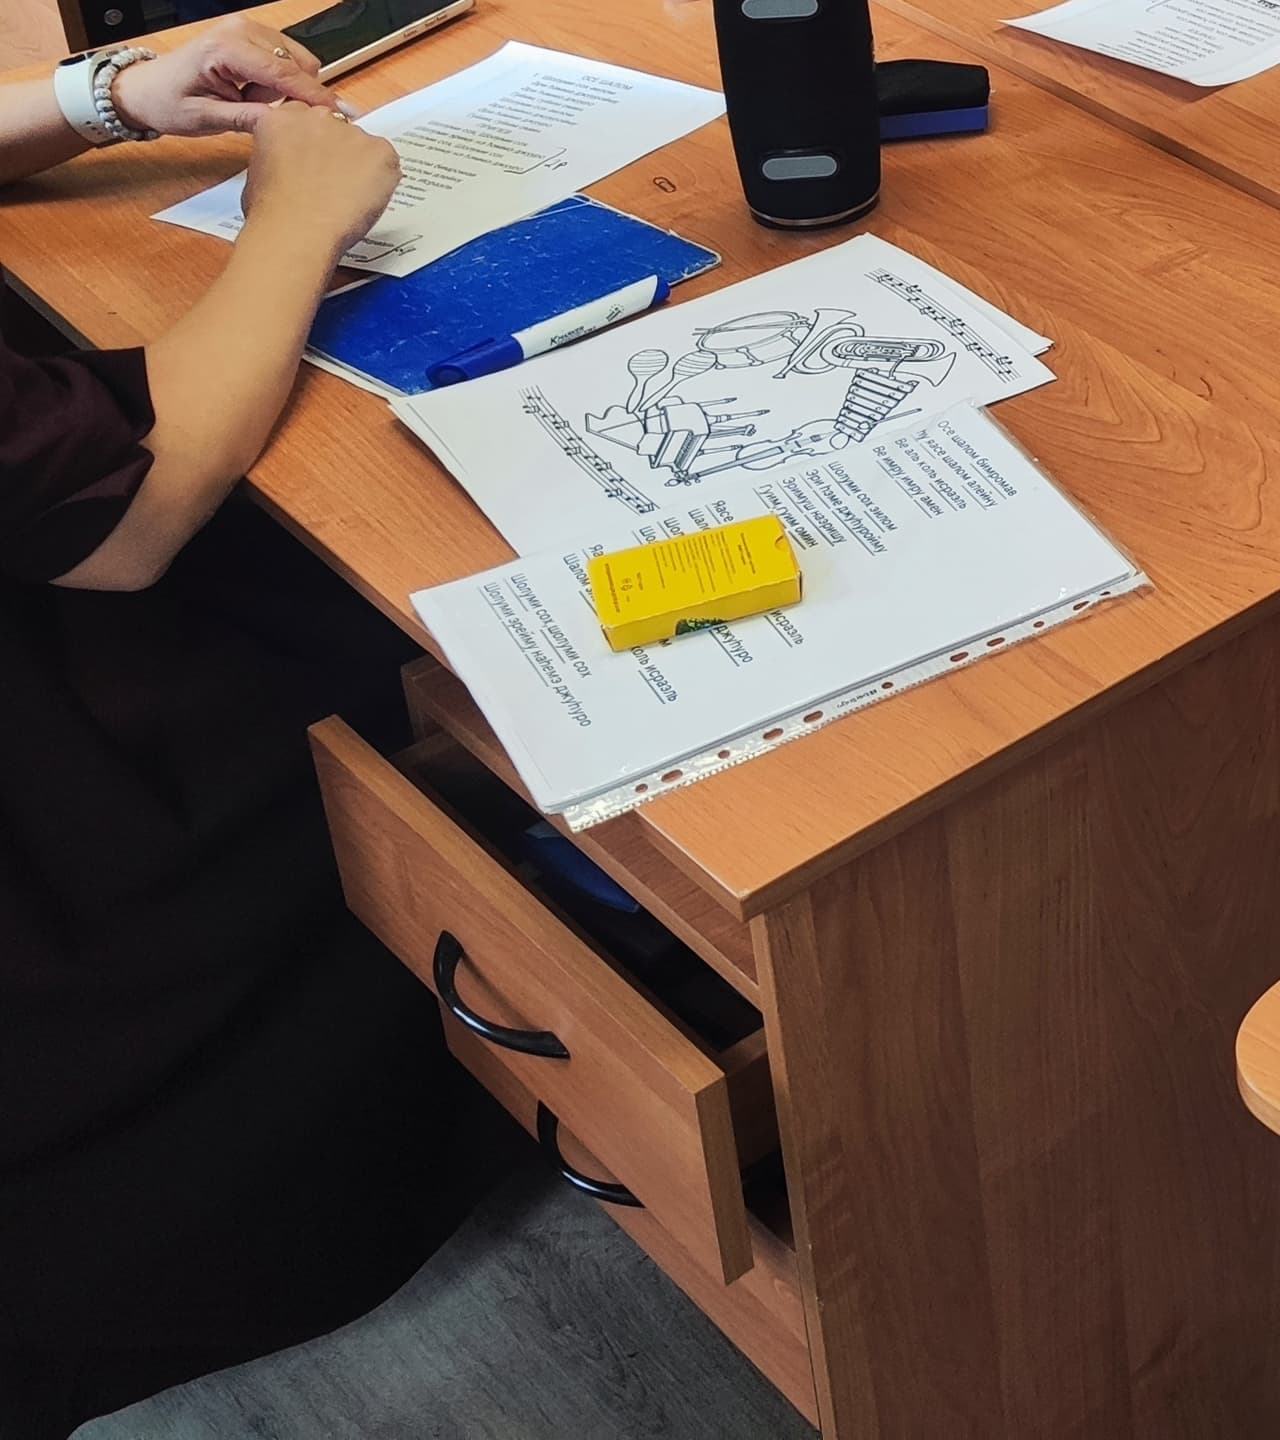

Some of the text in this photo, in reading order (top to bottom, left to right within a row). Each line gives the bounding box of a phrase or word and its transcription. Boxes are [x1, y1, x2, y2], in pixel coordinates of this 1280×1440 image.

[829, 462, 860, 495] Шолуми
[858, 493, 873, 508] сох
[873, 446, 944, 516] Ве имру имру амен
[895, 438, 966, 509] Ве аль коль исраэль
[927, 438, 946, 456] яасе
[943, 454, 970, 481] шалом
[967, 477, 998, 508] алейну
[938, 420, 1017, 496] Осе шалом бимромав
[796, 526, 818, 548] омин
